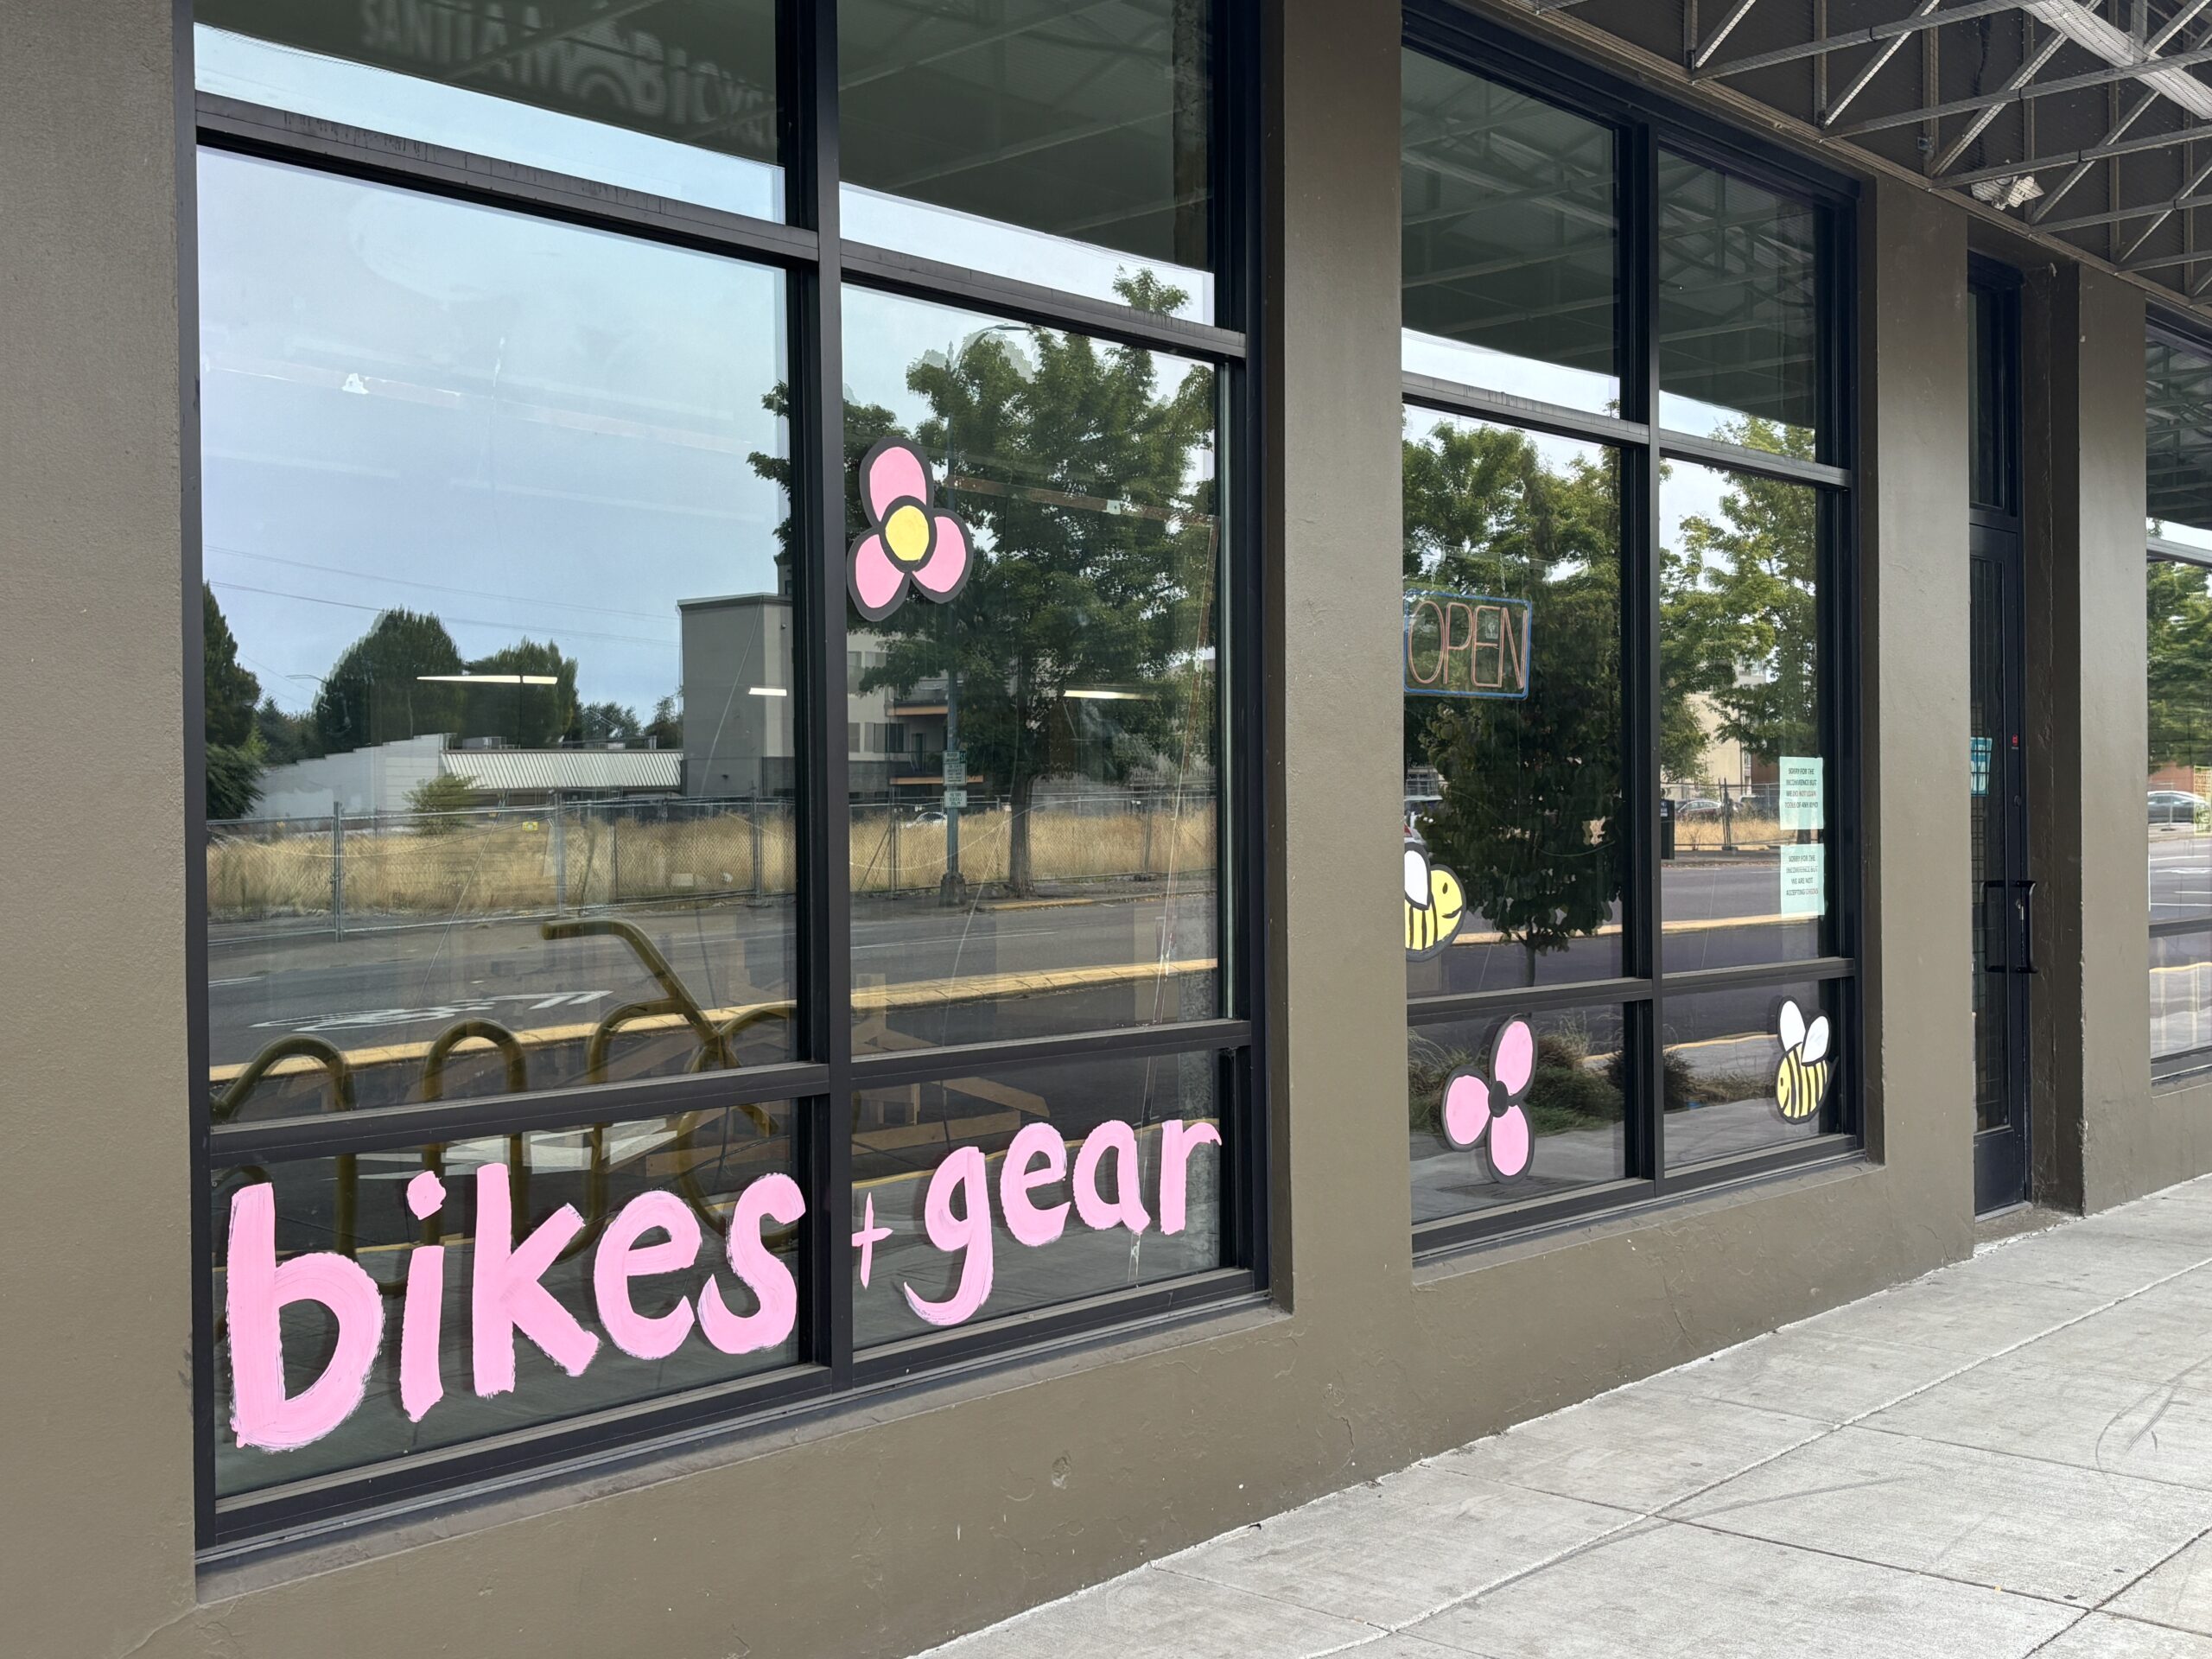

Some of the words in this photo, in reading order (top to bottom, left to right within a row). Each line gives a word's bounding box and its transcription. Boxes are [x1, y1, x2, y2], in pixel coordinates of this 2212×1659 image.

[1408, 601, 1528, 689] OPEN
[226, 1162, 806, 1452] bikes
[852, 1192, 893, 1288] +
[904, 1119, 1222, 1326] gear
